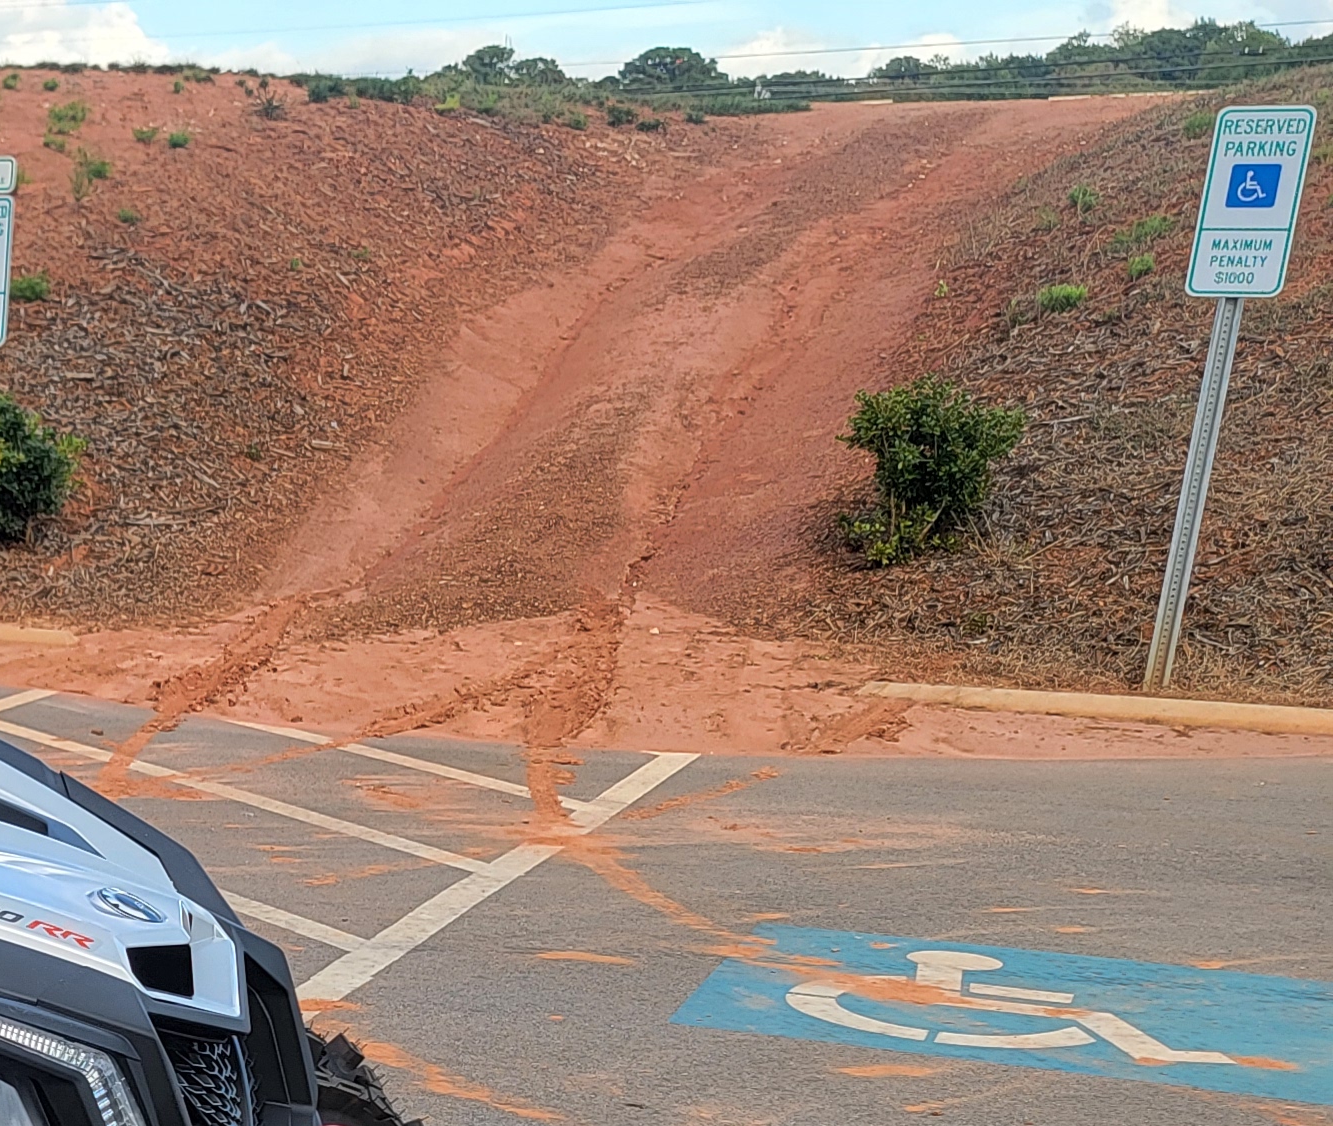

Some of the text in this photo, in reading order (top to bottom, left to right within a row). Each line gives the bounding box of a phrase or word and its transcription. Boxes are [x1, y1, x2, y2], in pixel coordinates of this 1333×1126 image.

[1223, 118, 1306, 135] RESERVED
[1224, 141, 1297, 157] PARKING
[1211, 239, 1273, 251] MAXIMUM
[1210, 255, 1268, 267] PENALTY
[1214, 271, 1254, 284] $1000
[26, 919, 95, 950] RR
